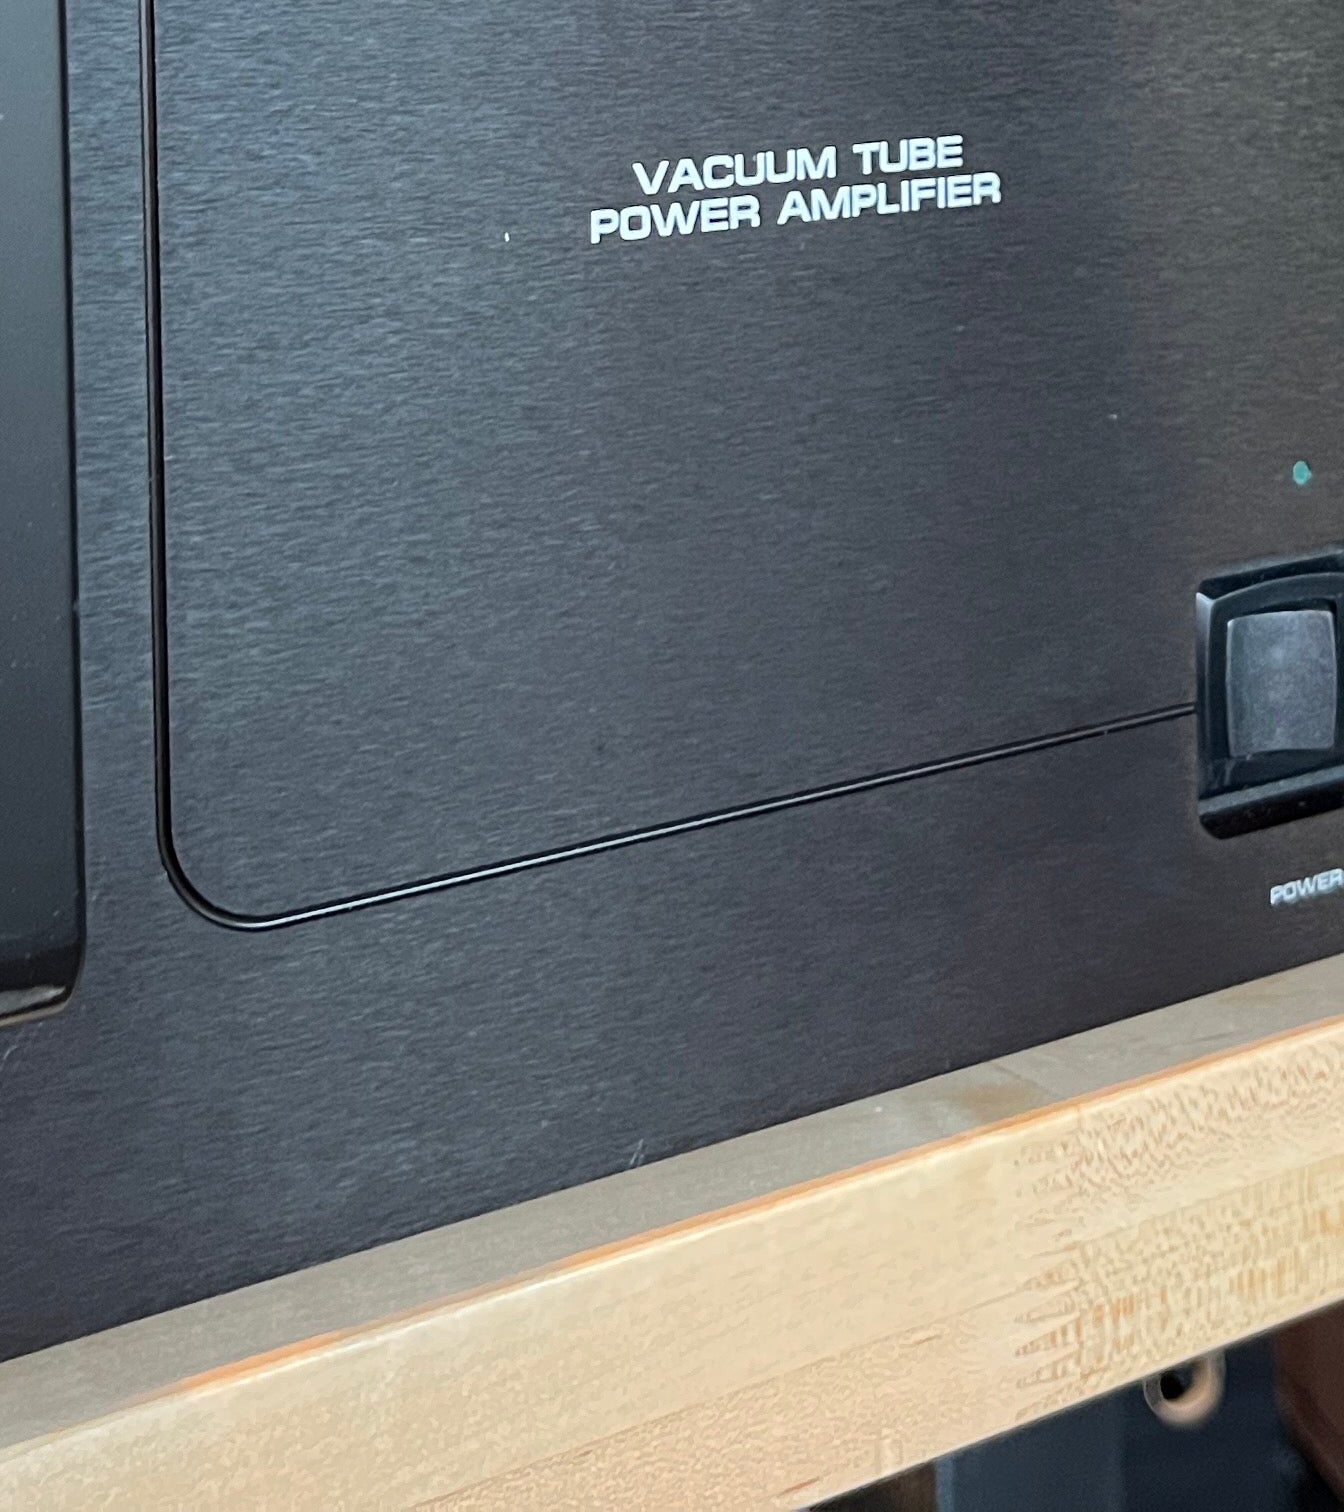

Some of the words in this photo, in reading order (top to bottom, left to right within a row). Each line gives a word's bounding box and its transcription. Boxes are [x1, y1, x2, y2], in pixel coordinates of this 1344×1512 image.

[631, 145, 837, 195] VACUUM
[851, 134, 964, 176] TUBE
[589, 194, 761, 244] POWER
[776, 171, 1002, 226] AMPLIFIER
